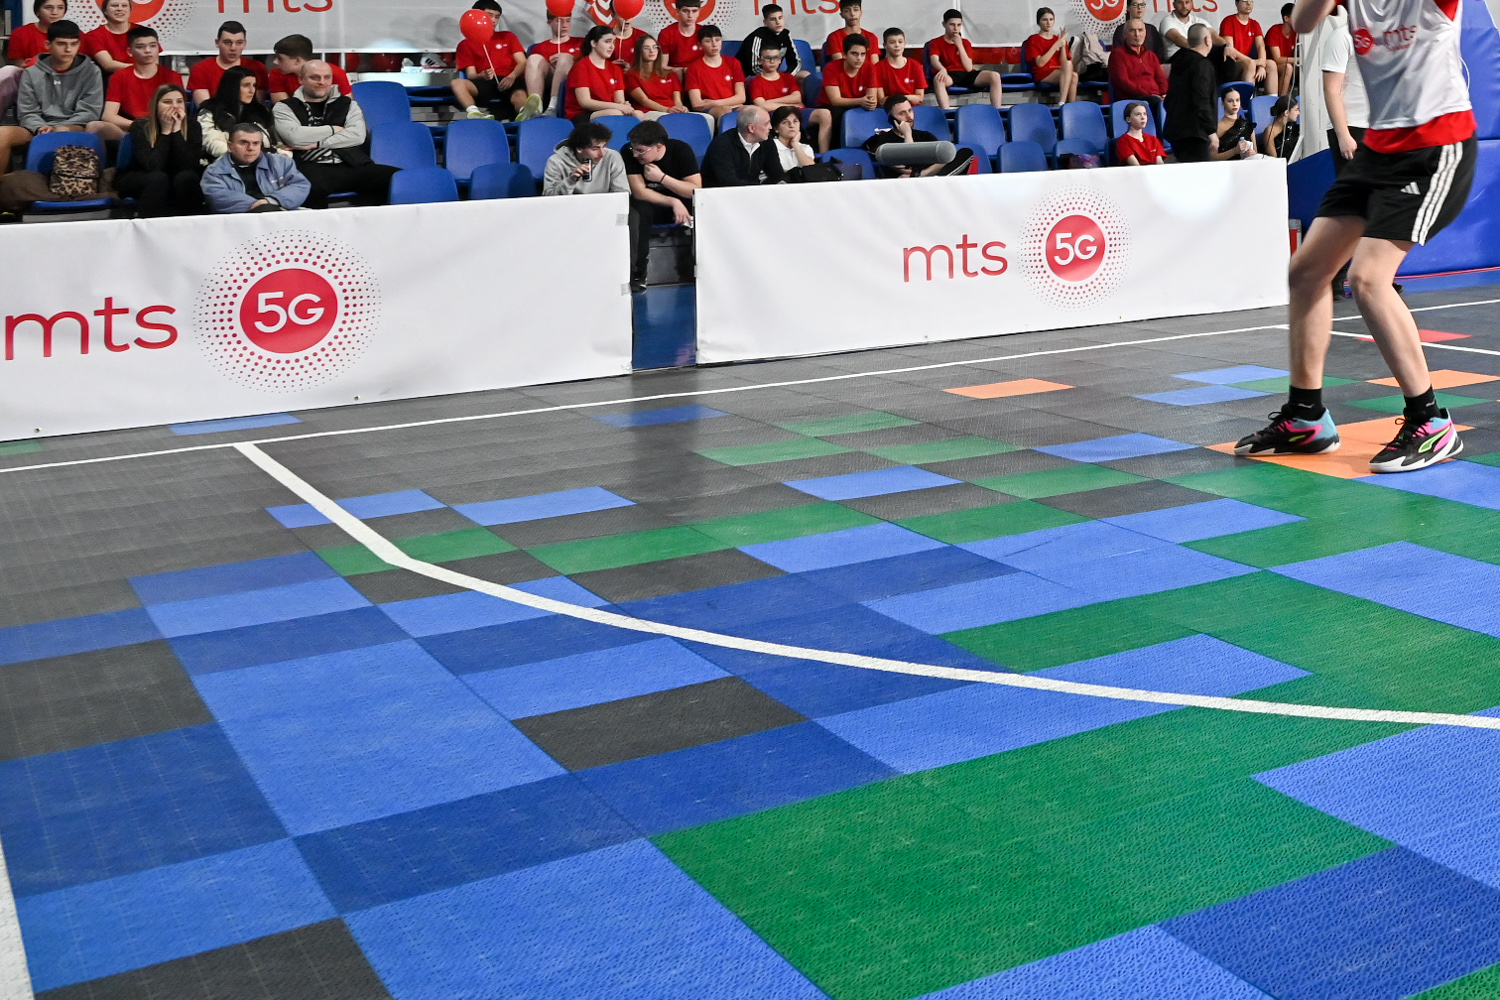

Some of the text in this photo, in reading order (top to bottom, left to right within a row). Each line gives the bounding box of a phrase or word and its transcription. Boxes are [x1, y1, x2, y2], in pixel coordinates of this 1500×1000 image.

[903, 232, 1098, 283] mts 5G
[4, 291, 325, 361] mts 5G
